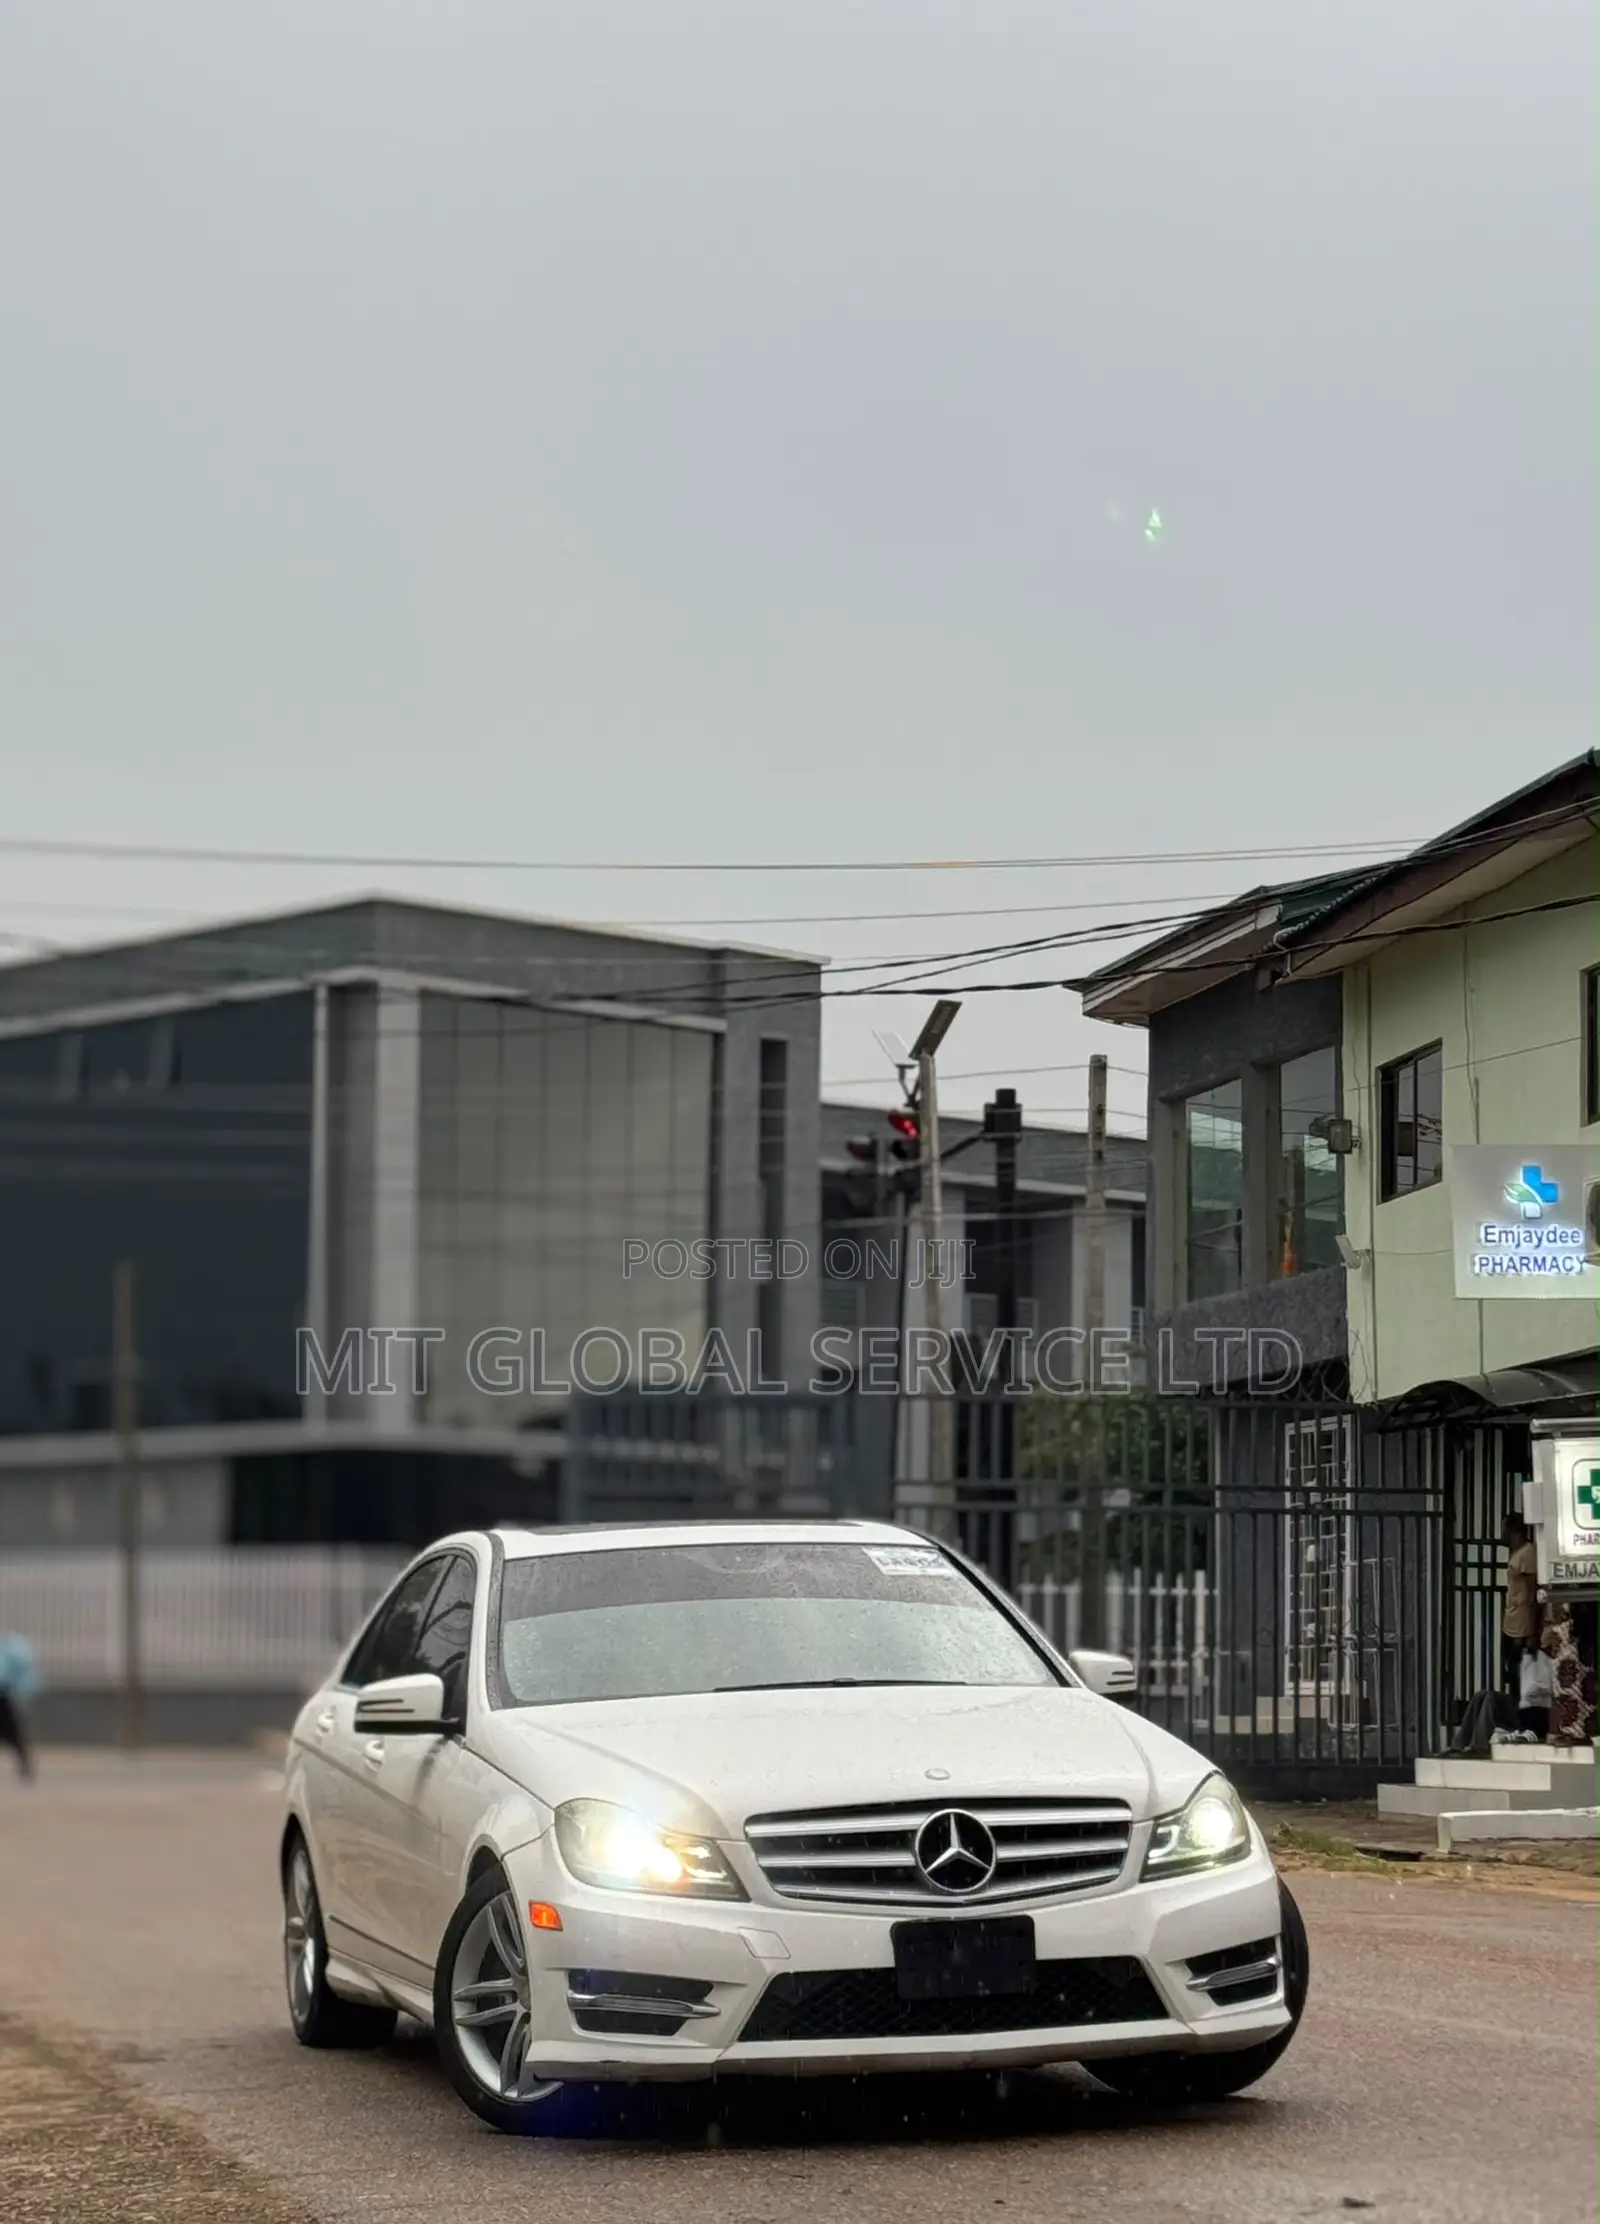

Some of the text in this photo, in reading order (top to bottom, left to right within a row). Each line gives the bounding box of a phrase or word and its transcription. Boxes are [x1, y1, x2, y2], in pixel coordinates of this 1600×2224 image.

[1483, 1225, 1581, 1248] Emjaydee
[1478, 1256, 1586, 1273] PHARMACY
[1553, 1562, 1600, 1578] EMJA
